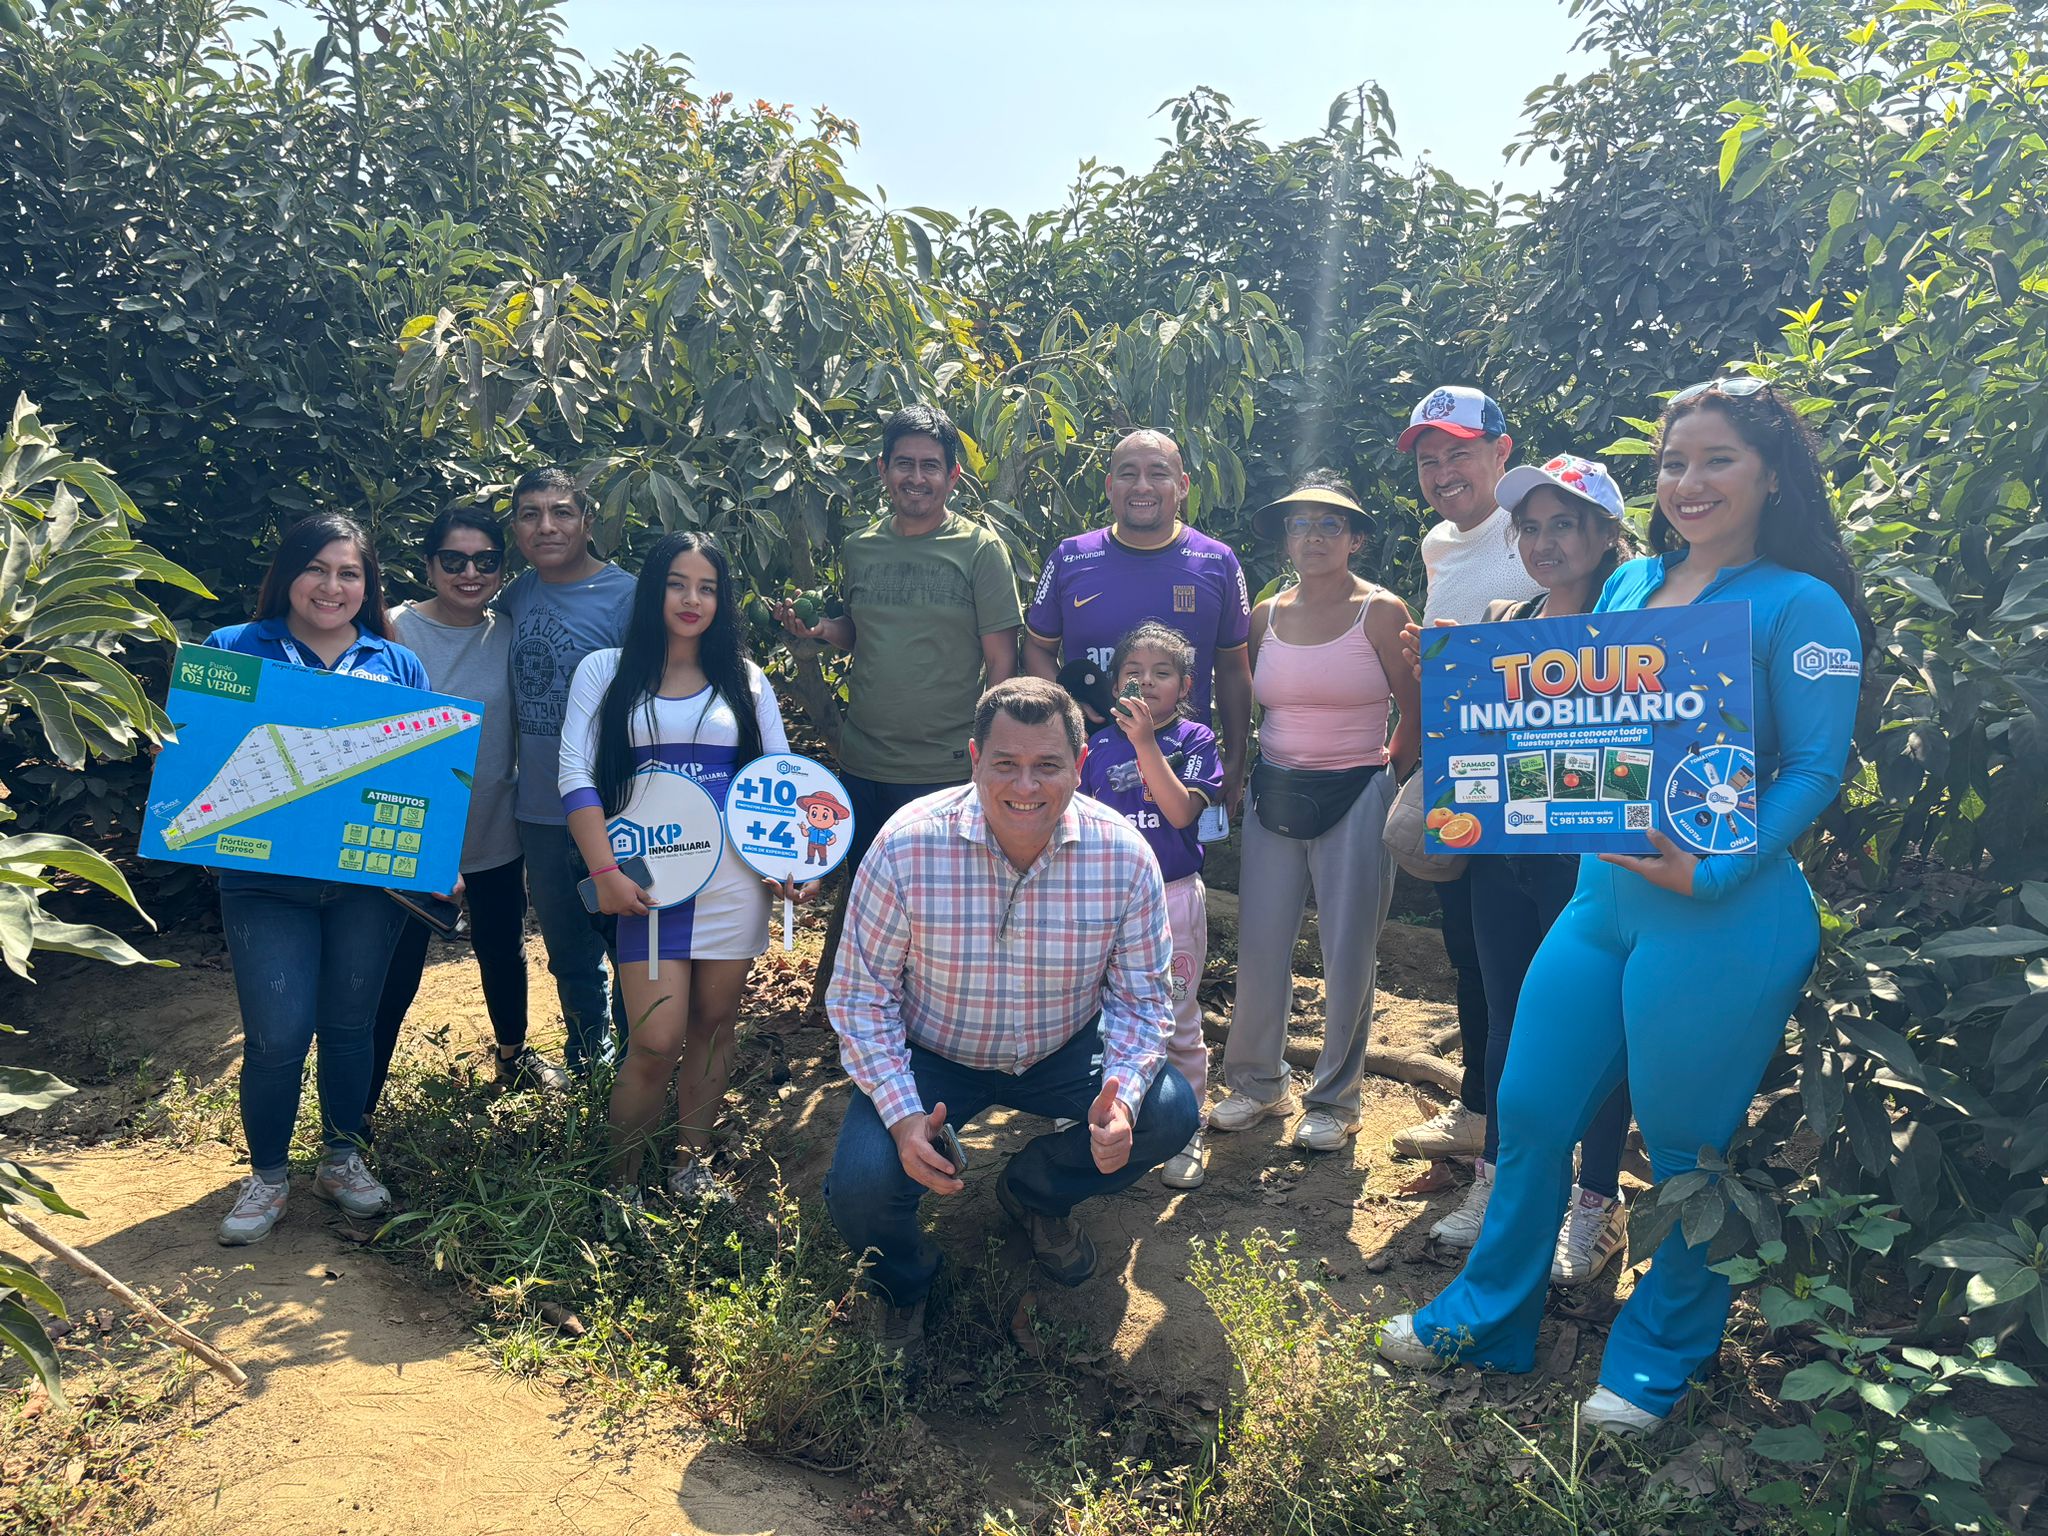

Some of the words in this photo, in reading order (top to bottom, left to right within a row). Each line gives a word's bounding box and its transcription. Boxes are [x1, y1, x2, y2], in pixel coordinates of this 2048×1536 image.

[1036, 564, 1055, 606] TORITO
[209, 661, 233, 671] Fundo
[1828, 652, 1848, 664] KP
[208, 667, 238, 682] ORO
[1492, 644, 1667, 702] TOUR
[206, 678, 251, 696] VERDE
[1460, 691, 1704, 732] INMOBILIARIO
[1511, 732, 1522, 740] Te
[1523, 730, 1568, 740] llevamos
[1578, 729, 1617, 738] conocer
[1619, 726, 1648, 736] todos
[1517, 738, 1554, 747] nuestros
[1555, 737, 1598, 747] proyectos
[1611, 735, 1641, 744] Huaral
[737, 777, 797, 807] +10
[1669, 779, 1679, 798] VINO
[367, 791, 425, 807] ATRIBUTOS
[1560, 817, 1576, 825] 981
[1577, 817, 1594, 825] 383
[1597, 816, 1614, 824] 957
[647, 823, 683, 847] KP
[747, 821, 795, 848] +4
[1730, 836, 1750, 848] VINO
[220, 844, 254, 855] Ingreso
[221, 836, 254, 848] Pórtico
[256, 840, 268, 850] de
[648, 840, 711, 856] INMOBILIARIA
